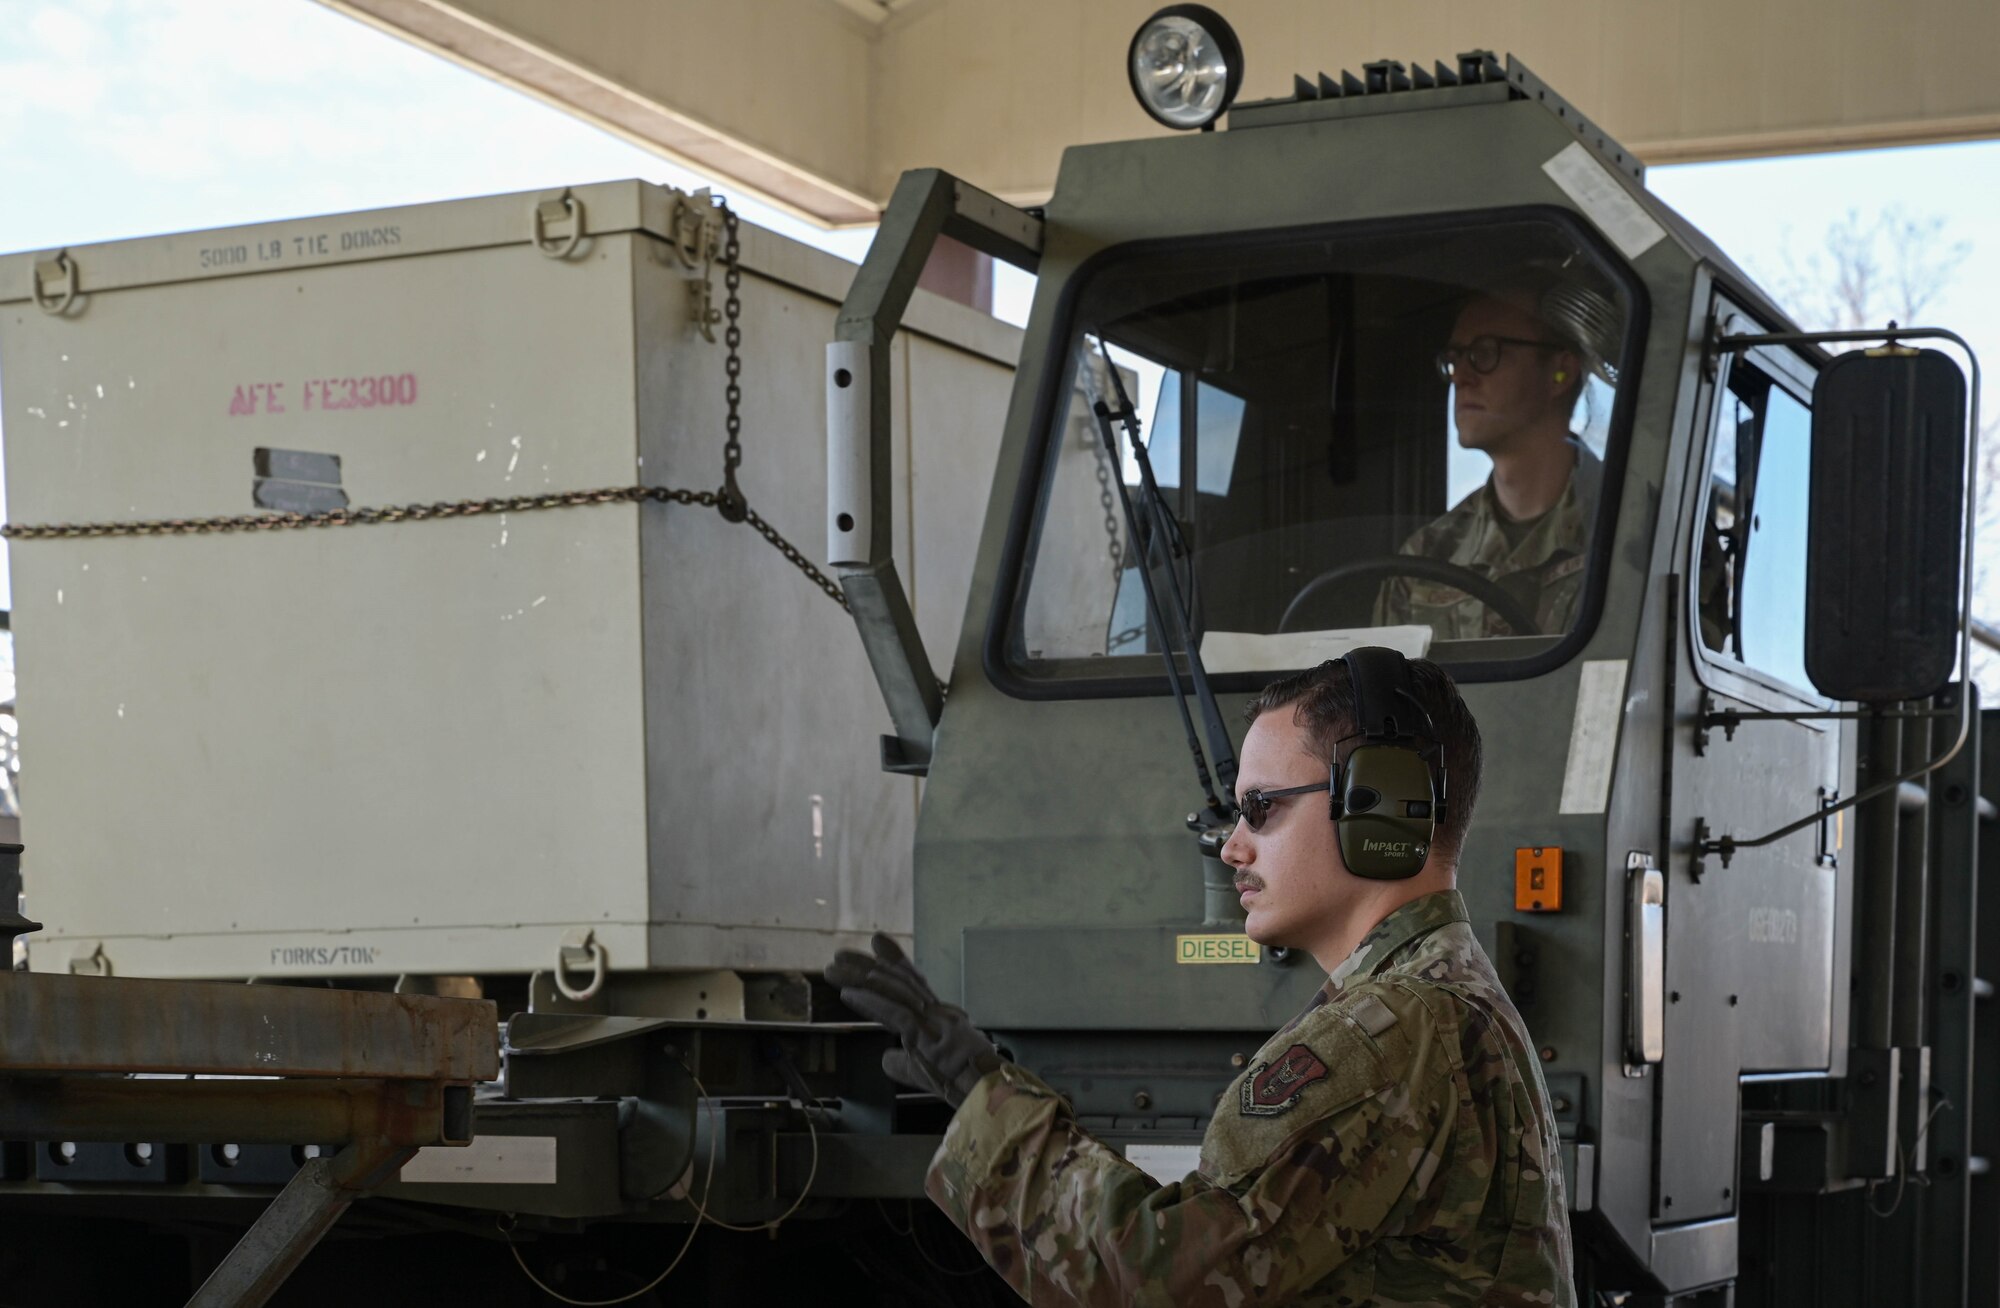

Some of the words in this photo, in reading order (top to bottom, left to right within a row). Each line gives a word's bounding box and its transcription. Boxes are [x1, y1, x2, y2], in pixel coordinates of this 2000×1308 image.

[201, 244, 247, 268] 5000
[258, 239, 282, 261] LB
[294, 234, 328, 256] TIE
[229, 383, 286, 416] AFE
[304, 373, 417, 412] FE3300
[1183, 941, 1256, 958] DIESEL
